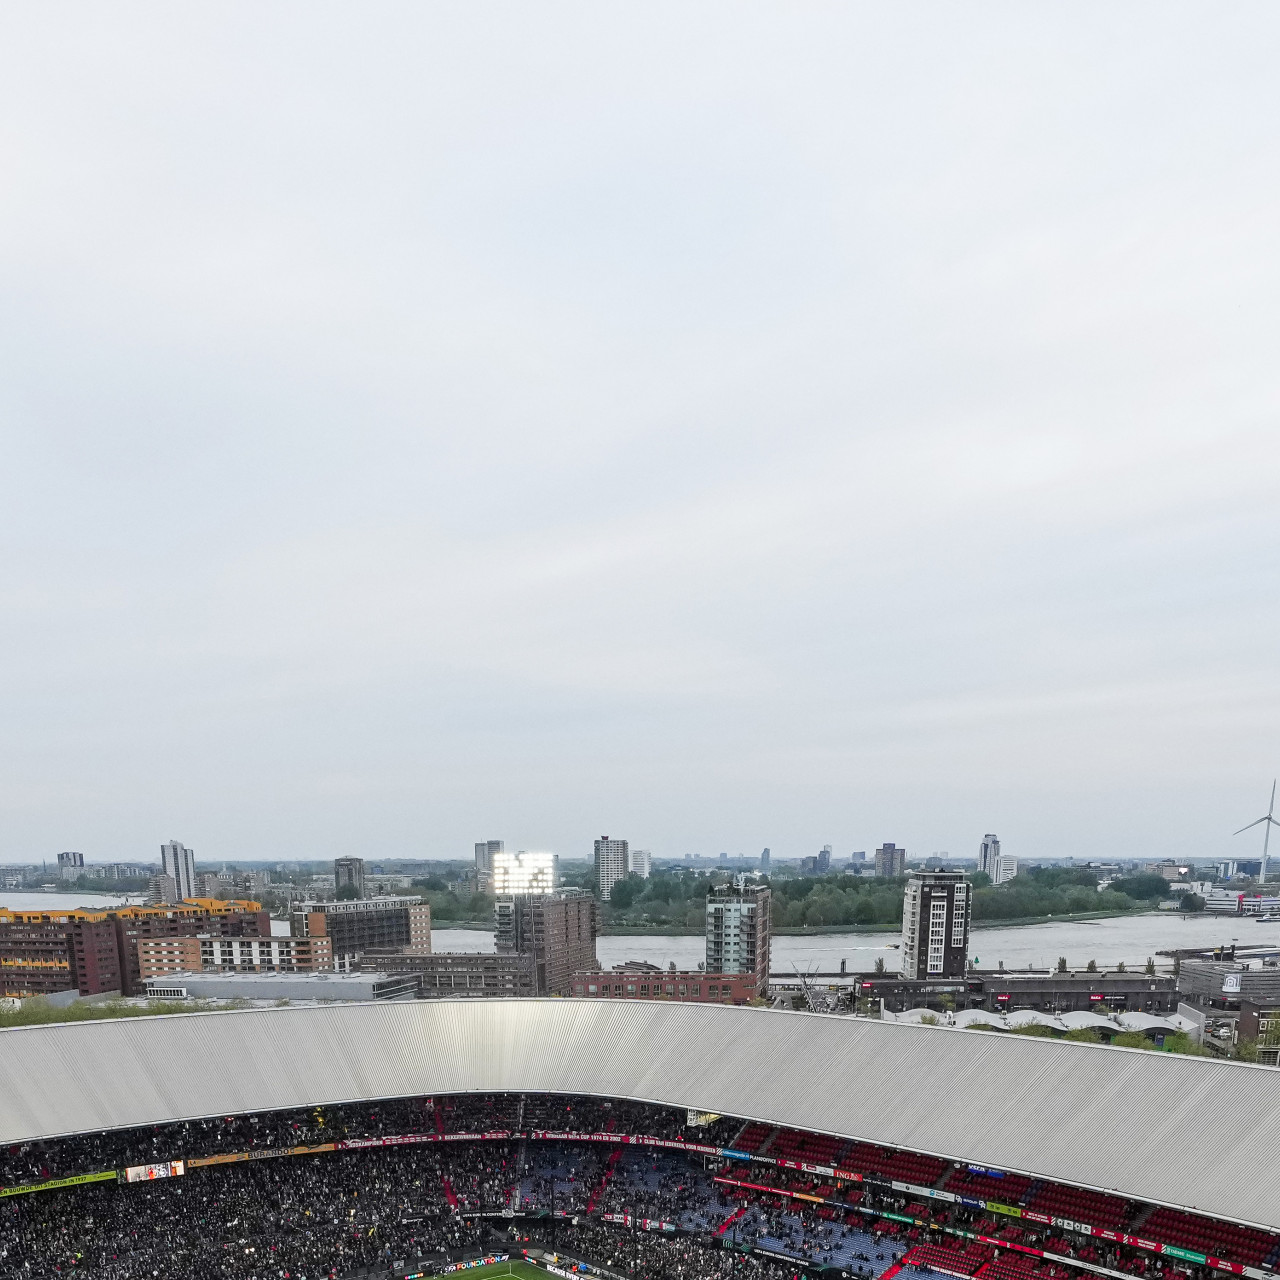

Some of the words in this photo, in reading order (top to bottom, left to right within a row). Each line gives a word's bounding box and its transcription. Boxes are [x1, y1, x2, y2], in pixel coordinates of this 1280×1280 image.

[836, 1171, 849, 1180] ING
[457, 1256, 500, 1270] FOUNDATION
[546, 1264, 566, 1278] BECAUSE
